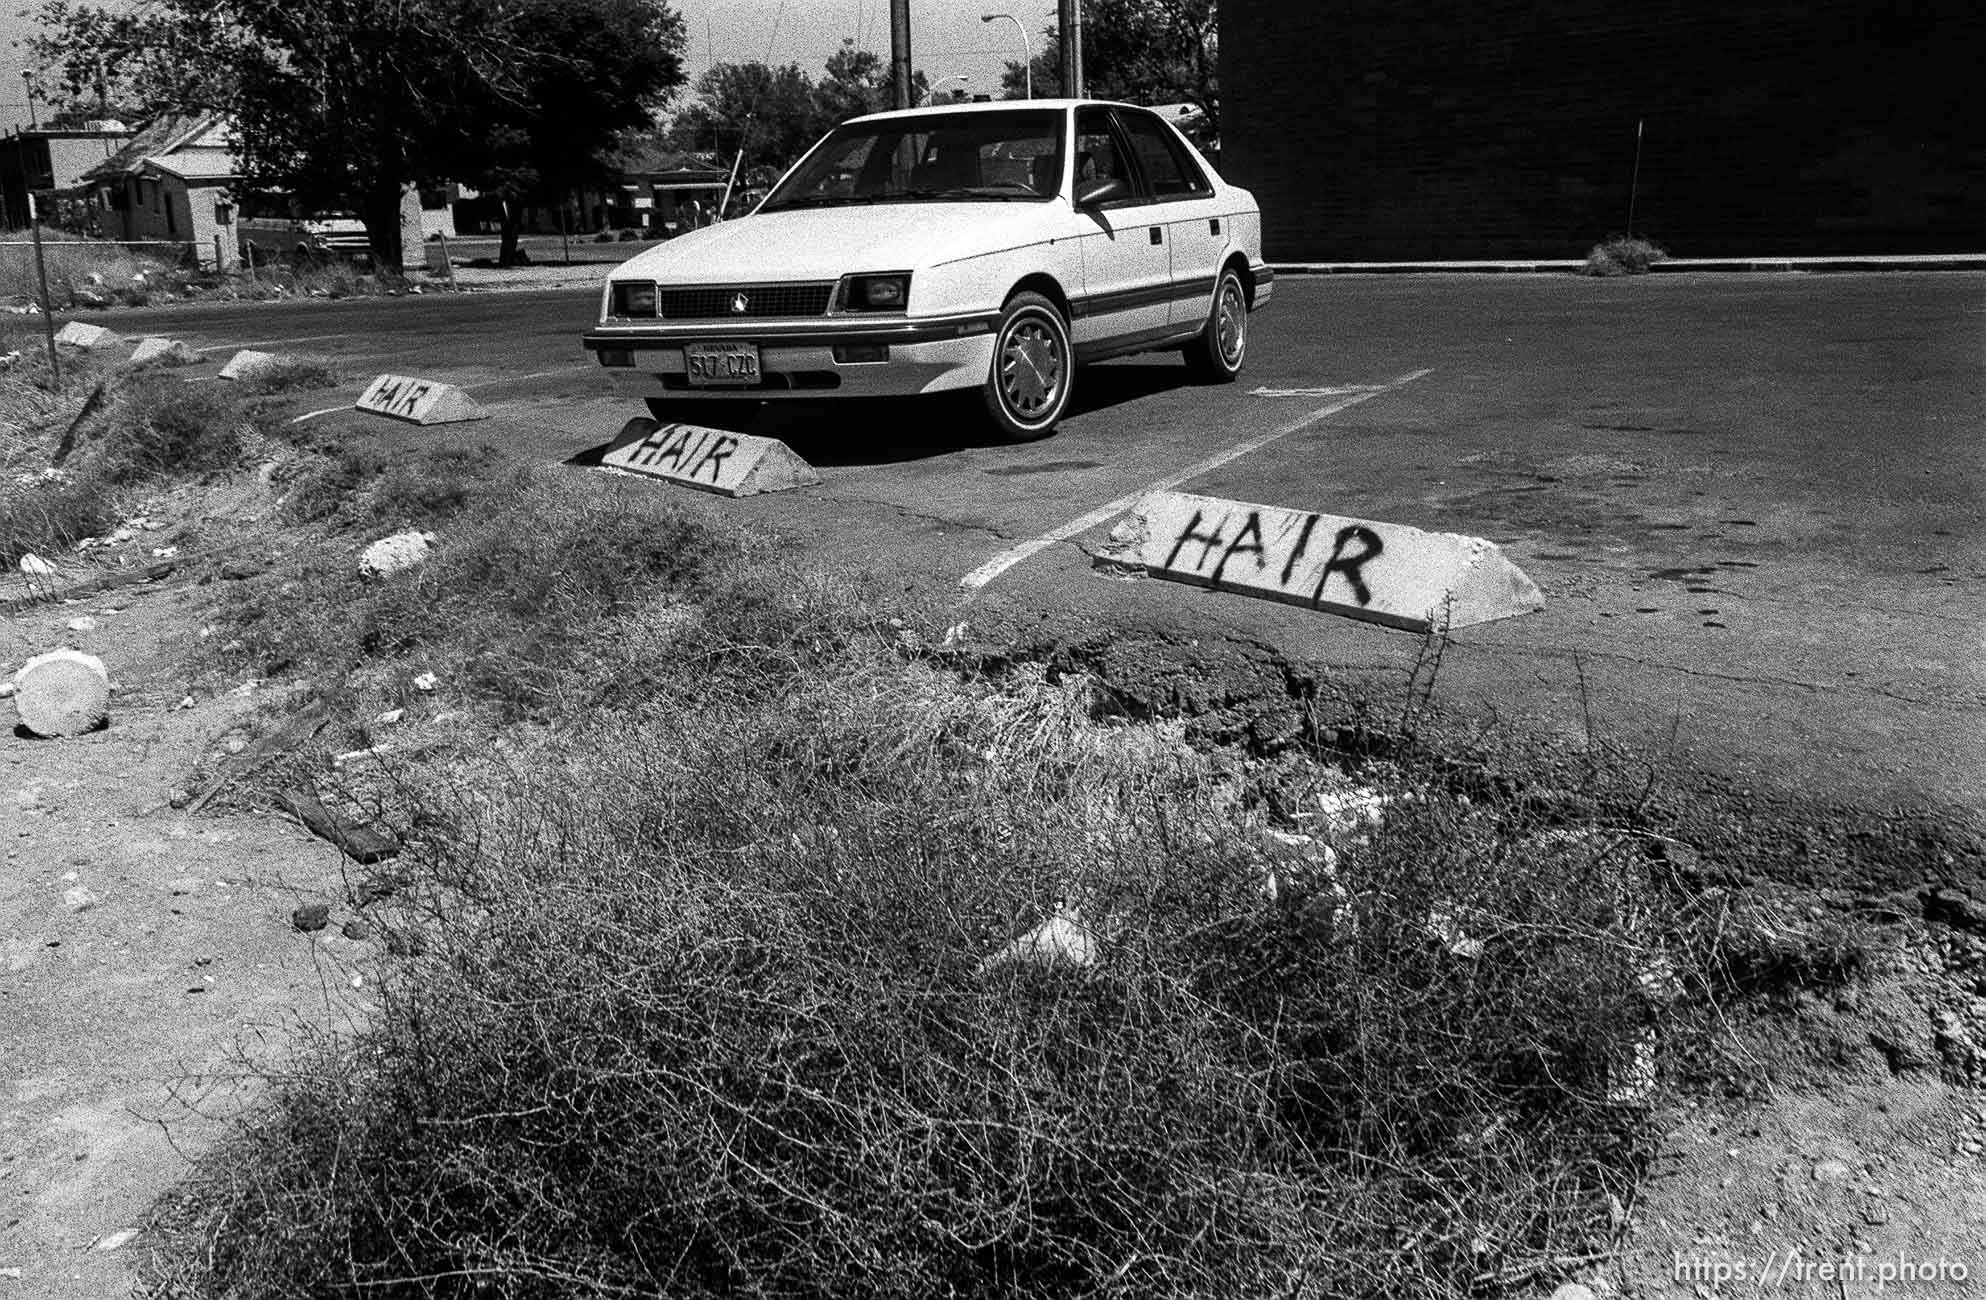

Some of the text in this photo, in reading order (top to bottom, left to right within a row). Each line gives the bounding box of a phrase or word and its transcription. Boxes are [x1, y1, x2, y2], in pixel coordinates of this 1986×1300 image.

[369, 379, 430, 415] HAIR
[627, 423, 739, 484] HAIR
[1164, 509, 1384, 607] HAIR
